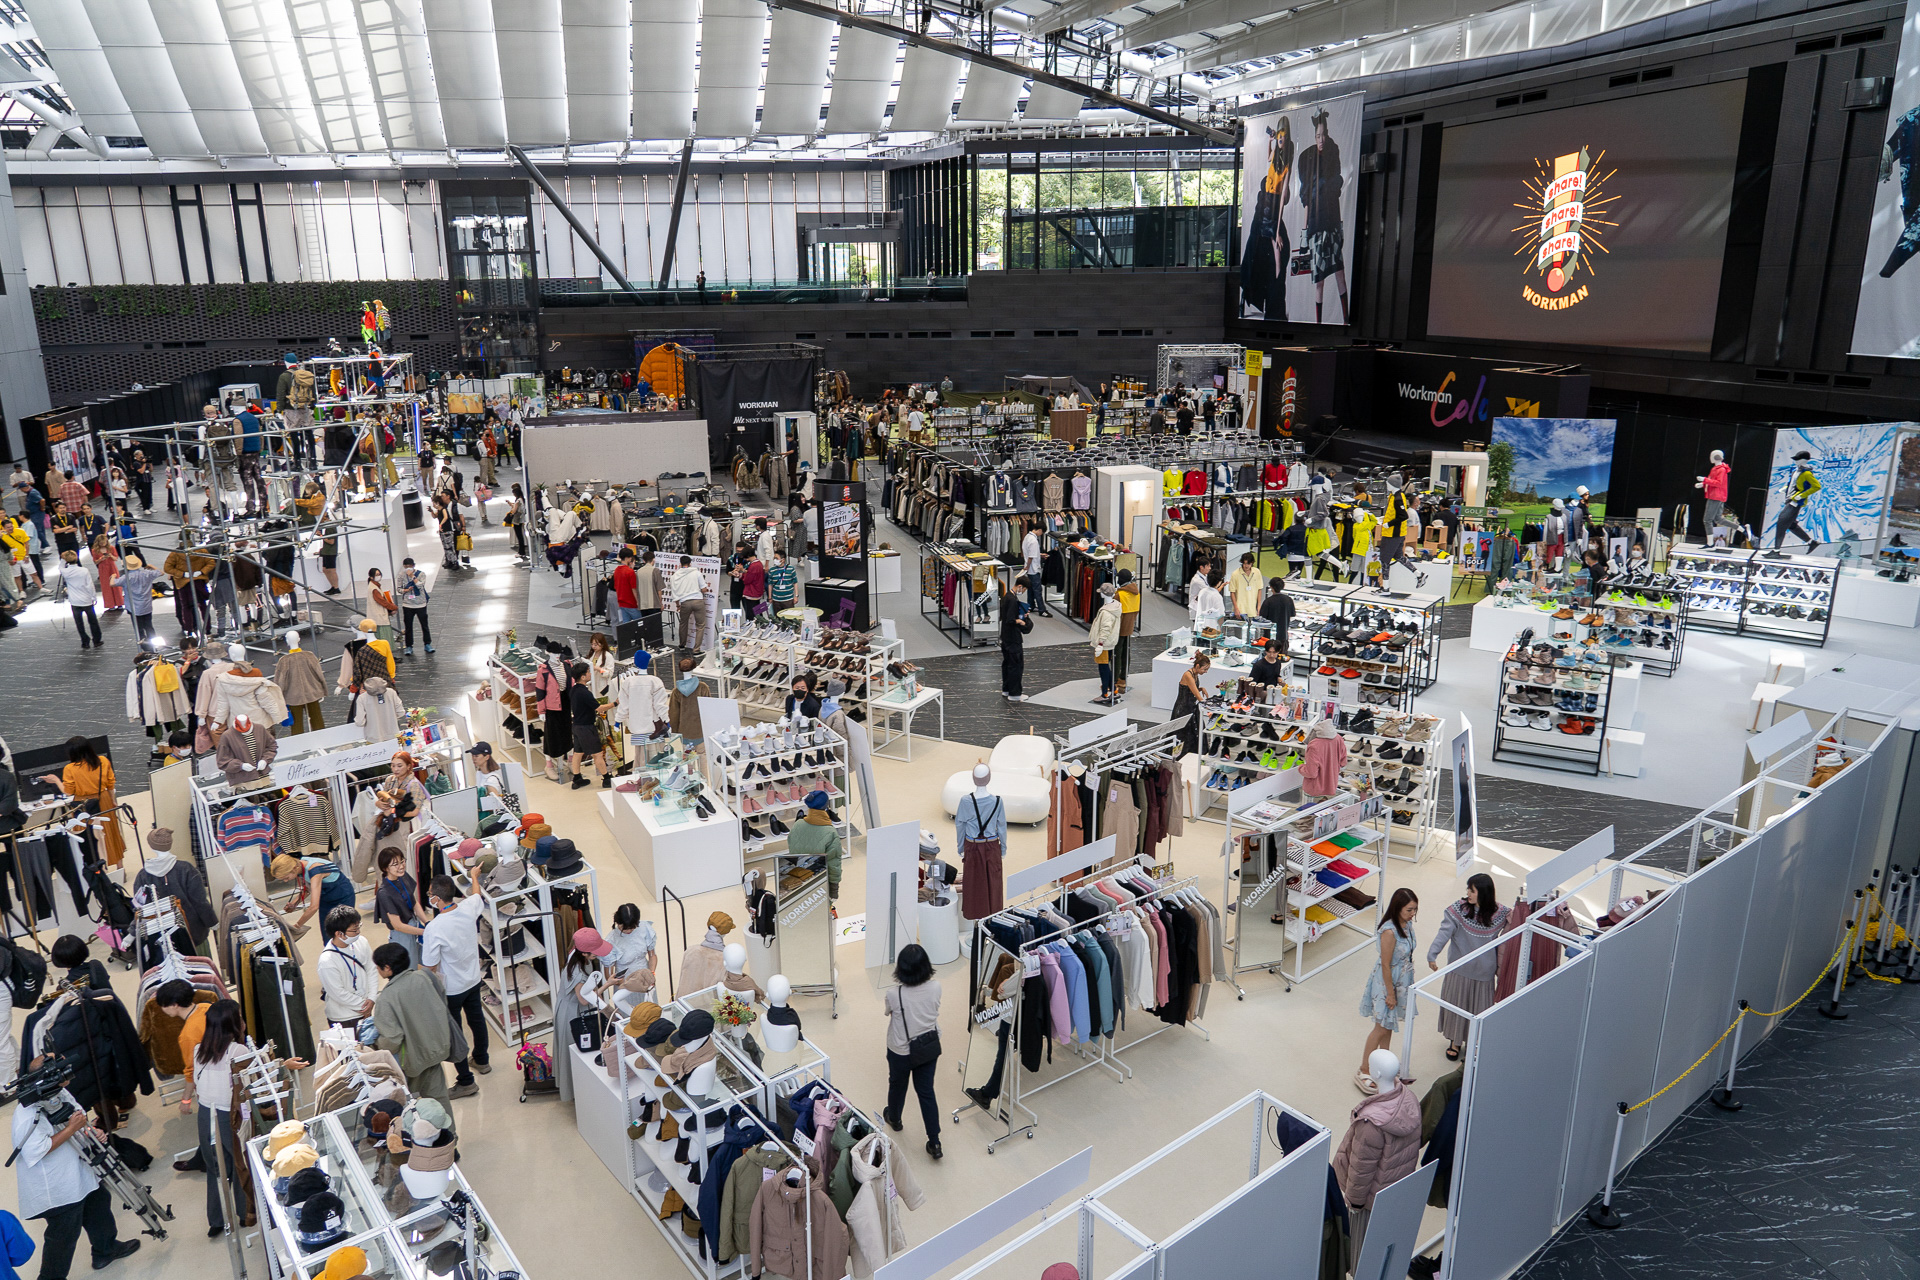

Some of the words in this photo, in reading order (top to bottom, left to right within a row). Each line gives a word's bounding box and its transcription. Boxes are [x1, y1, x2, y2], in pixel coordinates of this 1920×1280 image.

[1548, 174, 1583, 200] share!
[1545, 204, 1579, 229] share!
[1542, 235, 1576, 259] share!
[1522, 284, 1589, 310] WORKMAN
[739, 401, 779, 409] WORKMAN
[1398, 382, 1452, 404] Workman
[1241, 863, 1286, 907] WORKMAN
[779, 887, 827, 926] WORKMAN
[974, 997, 1013, 1024] WORKMAN
